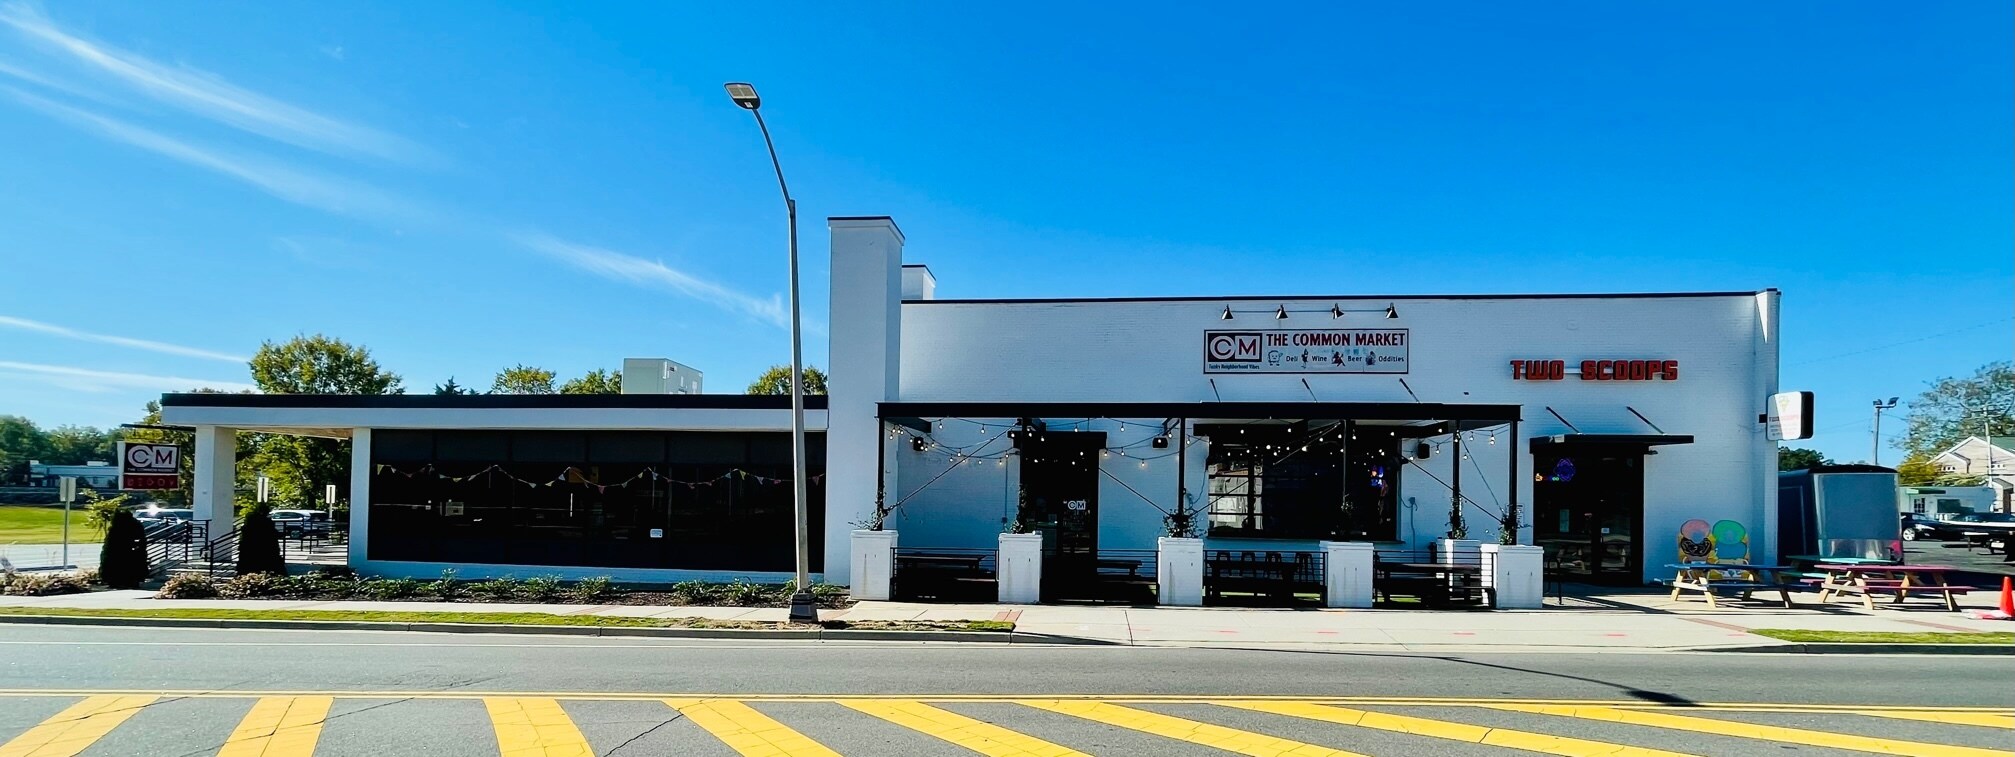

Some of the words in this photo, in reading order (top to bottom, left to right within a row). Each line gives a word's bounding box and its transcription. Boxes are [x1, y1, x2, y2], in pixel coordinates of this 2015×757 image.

[1211, 336, 1259, 359] CM
[1266, 333, 1288, 346] THE
[1292, 333, 1350, 346] COMMON
[1355, 333, 1405, 346] MARKET
[1510, 360, 1565, 381] TWO
[1580, 360, 1678, 381] SCOOPS
[129, 446, 175, 467] CM
